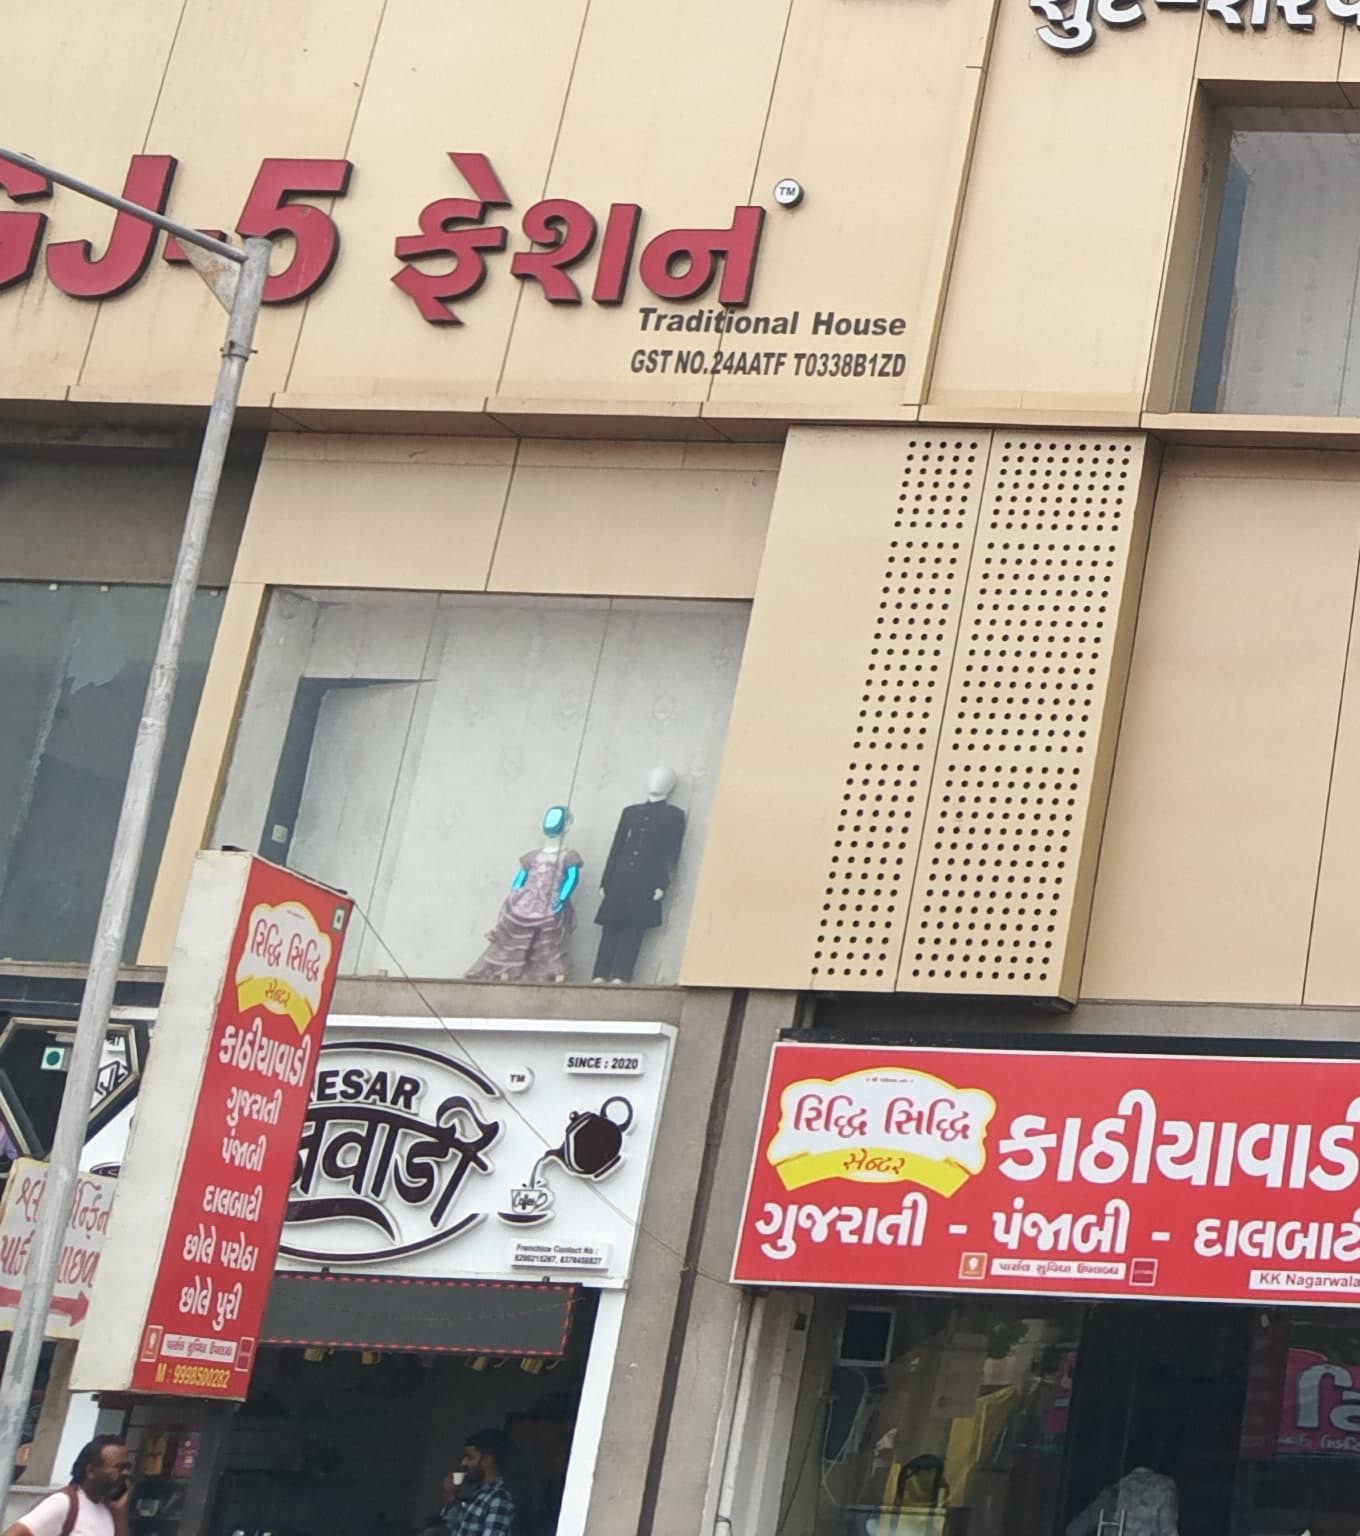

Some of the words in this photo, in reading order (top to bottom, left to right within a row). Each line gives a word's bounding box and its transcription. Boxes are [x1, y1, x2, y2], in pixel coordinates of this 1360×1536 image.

[638, 308, 799, 335] Traditional
[812, 312, 907, 336] House
[631, 350, 672, 375] GST
[568, 1057, 601, 1068] SINCE
[611, 1058, 638, 1069] 2020
[1259, 1274, 1281, 1286] KK
